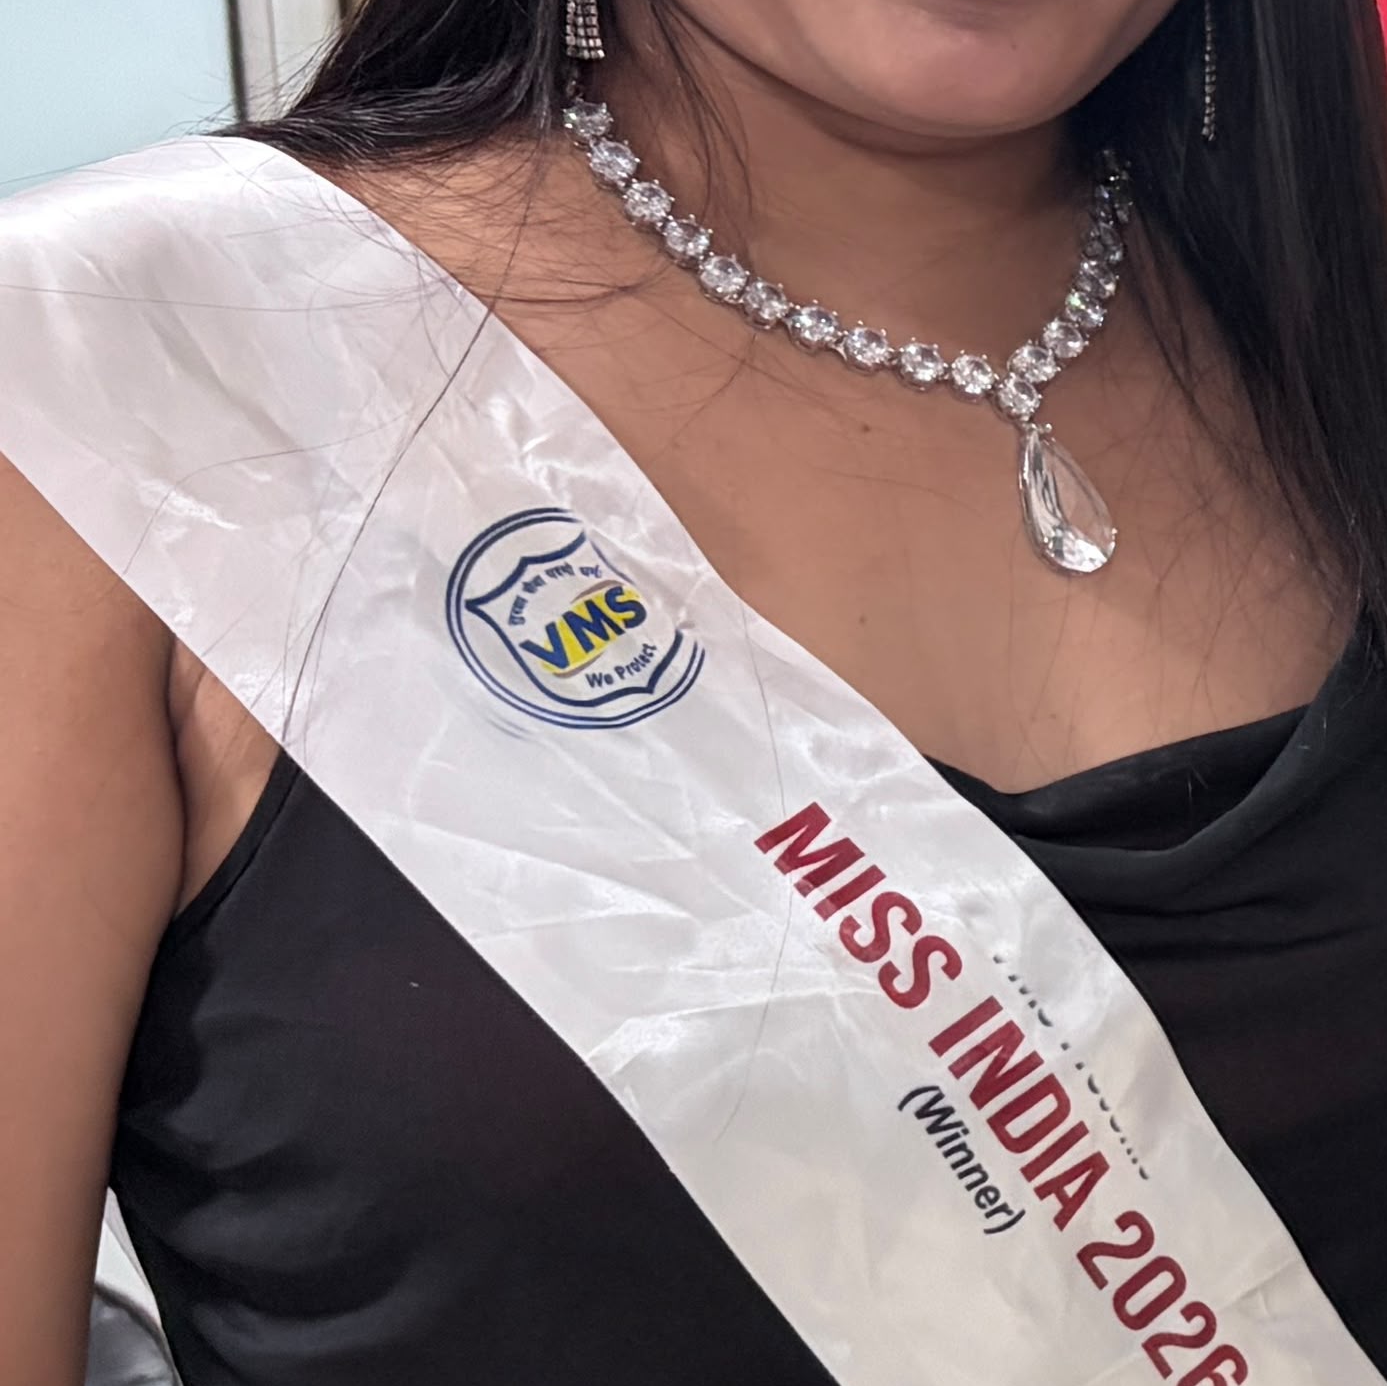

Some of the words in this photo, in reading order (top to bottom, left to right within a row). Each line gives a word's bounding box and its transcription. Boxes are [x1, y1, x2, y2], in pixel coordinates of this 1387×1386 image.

[518, 585, 648, 669] VMS
[585, 672, 614, 688] We
[616, 643, 658, 681] Protect
[754, 801, 963, 1009] MISS
[928, 995, 1110, 1232] INDIA
[897, 1085, 1026, 1236] (Winner)
